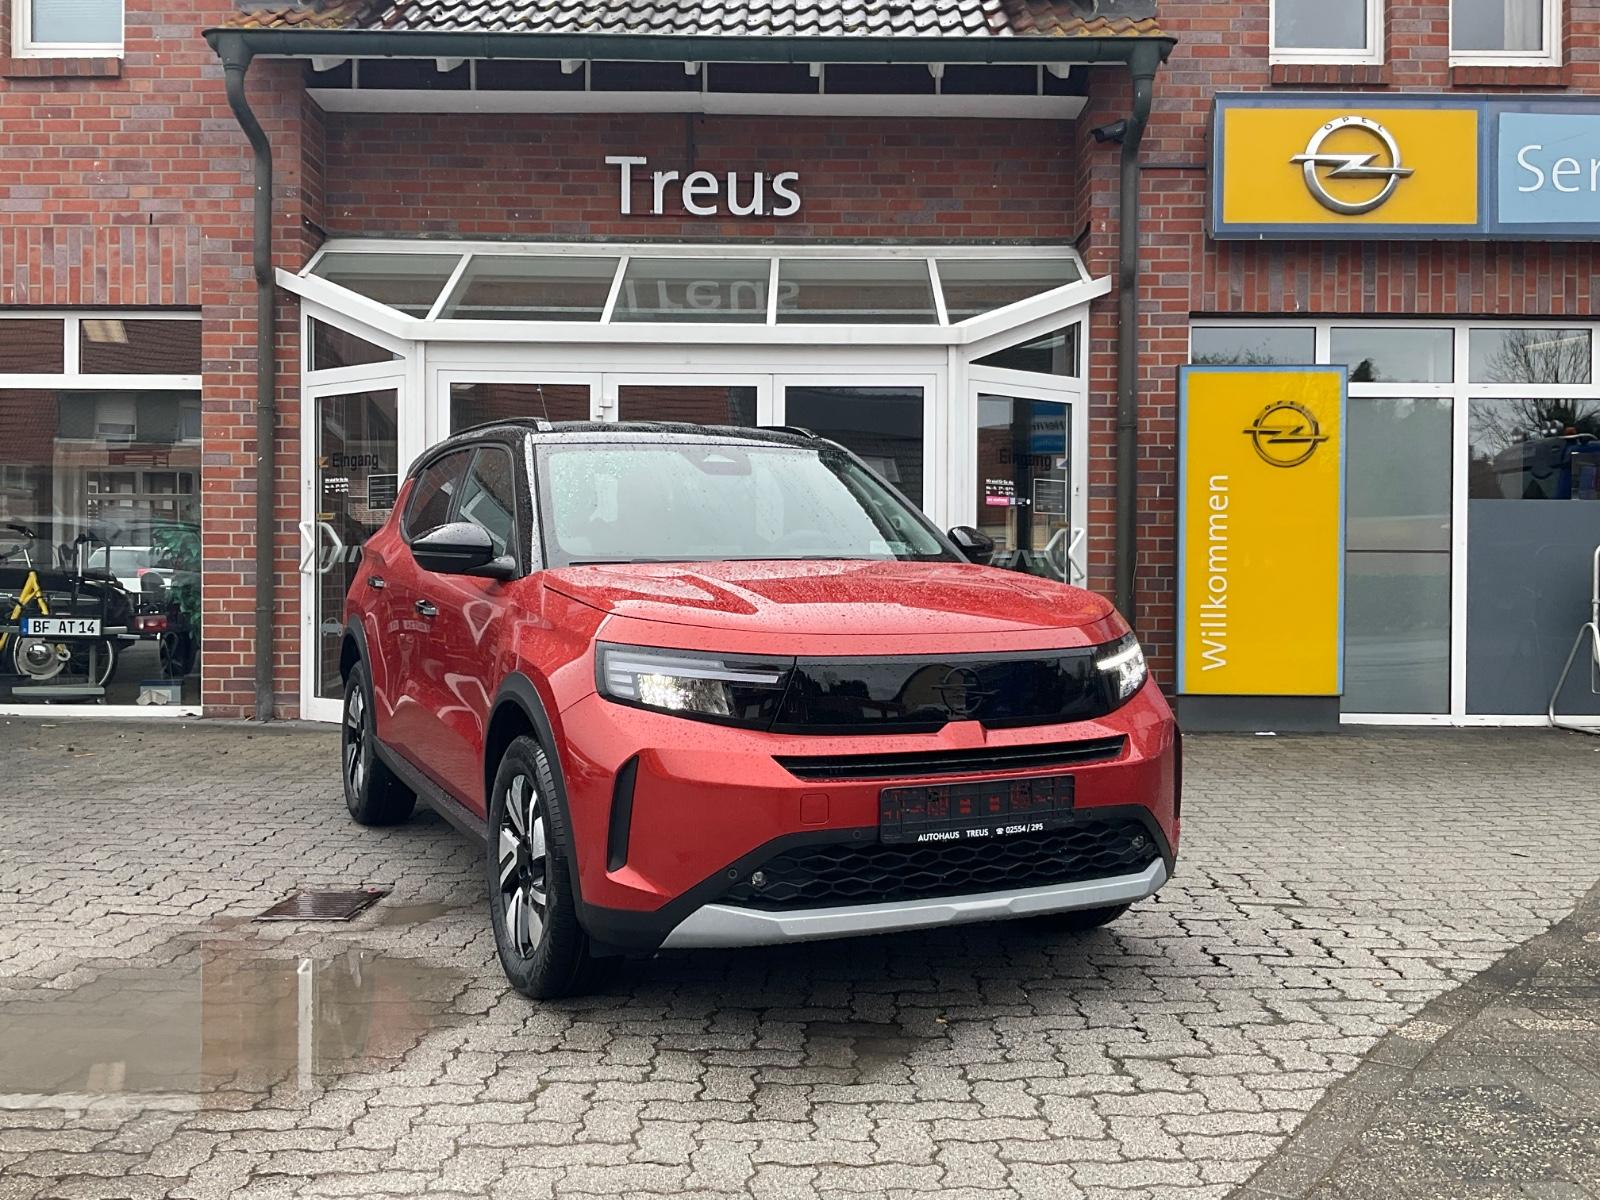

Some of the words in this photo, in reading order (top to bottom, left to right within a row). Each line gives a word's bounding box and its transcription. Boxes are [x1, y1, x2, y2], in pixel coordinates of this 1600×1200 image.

[1324, 116, 1383, 132] OPEL
[1517, 144, 1600, 193] Ser
[605, 156, 801, 216] Treus
[332, 453, 379, 471] Eingang
[999, 448, 1052, 471] Eingang
[1200, 474, 1229, 671] Willkommen
[33, 621, 50, 633] BF
[917, 831, 960, 842] AUTOHAUS
[965, 828, 989, 838] TREUS
